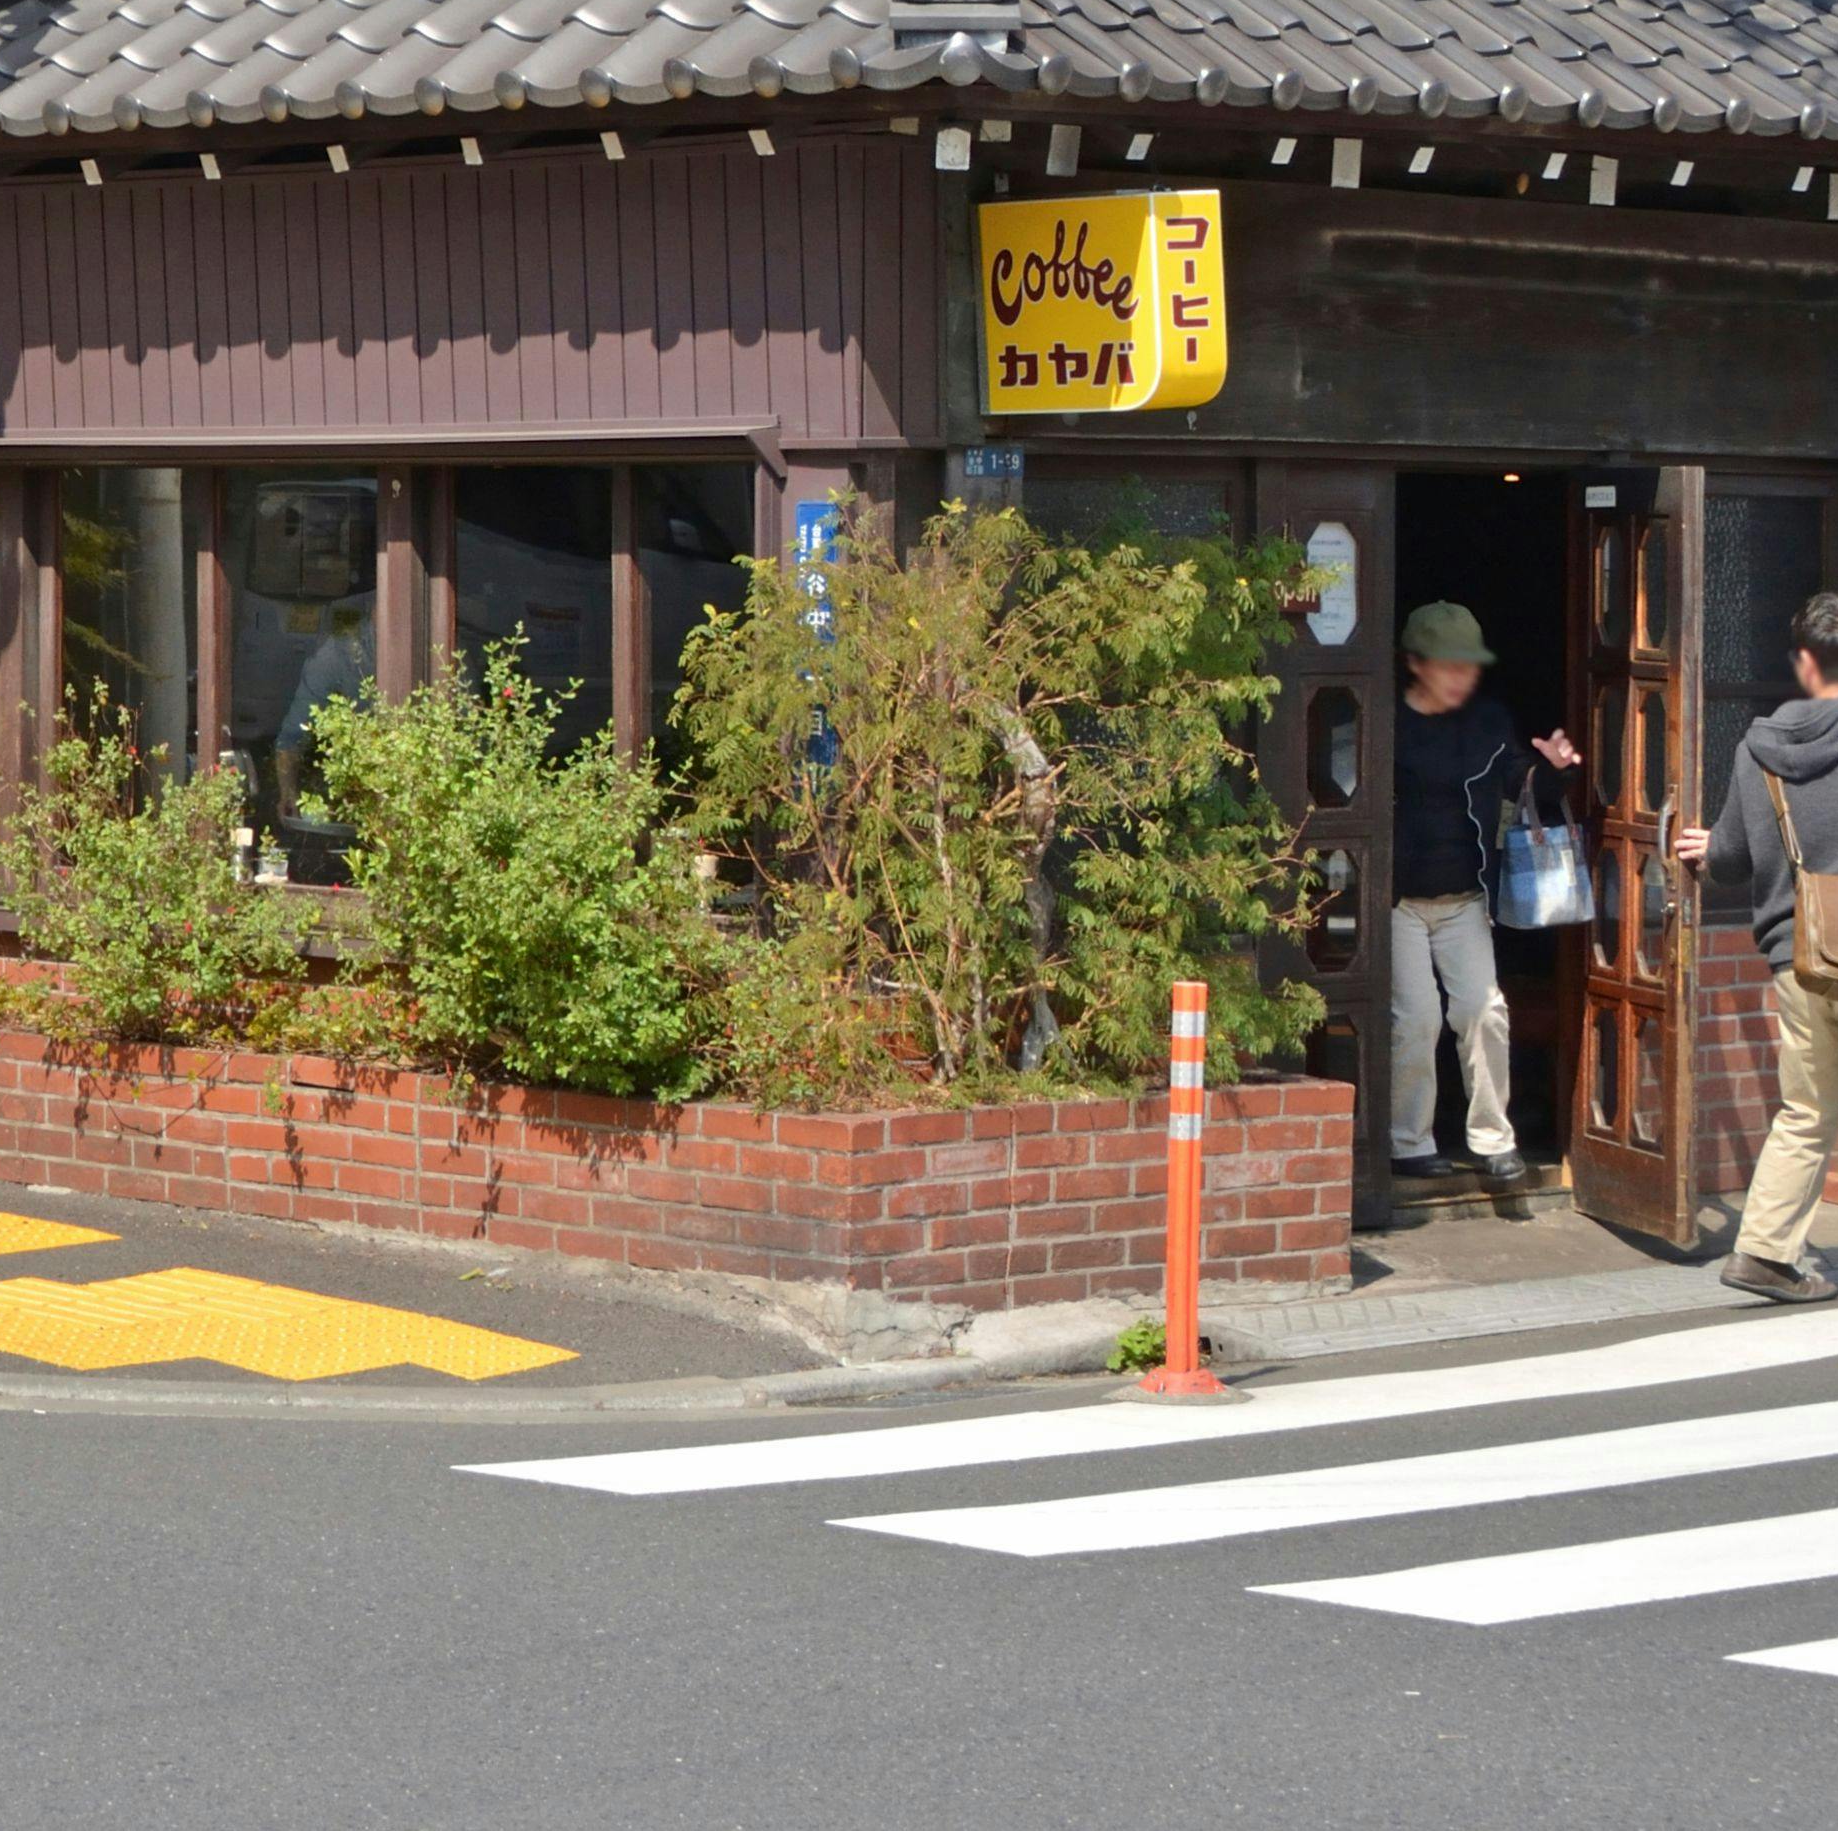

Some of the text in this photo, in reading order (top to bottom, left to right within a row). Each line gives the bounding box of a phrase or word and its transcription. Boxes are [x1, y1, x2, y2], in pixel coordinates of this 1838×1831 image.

[991, 219, 1139, 326] Coffee
[1165, 217, 1210, 363] コーヒー
[998, 342, 1135, 387] カヤバ
